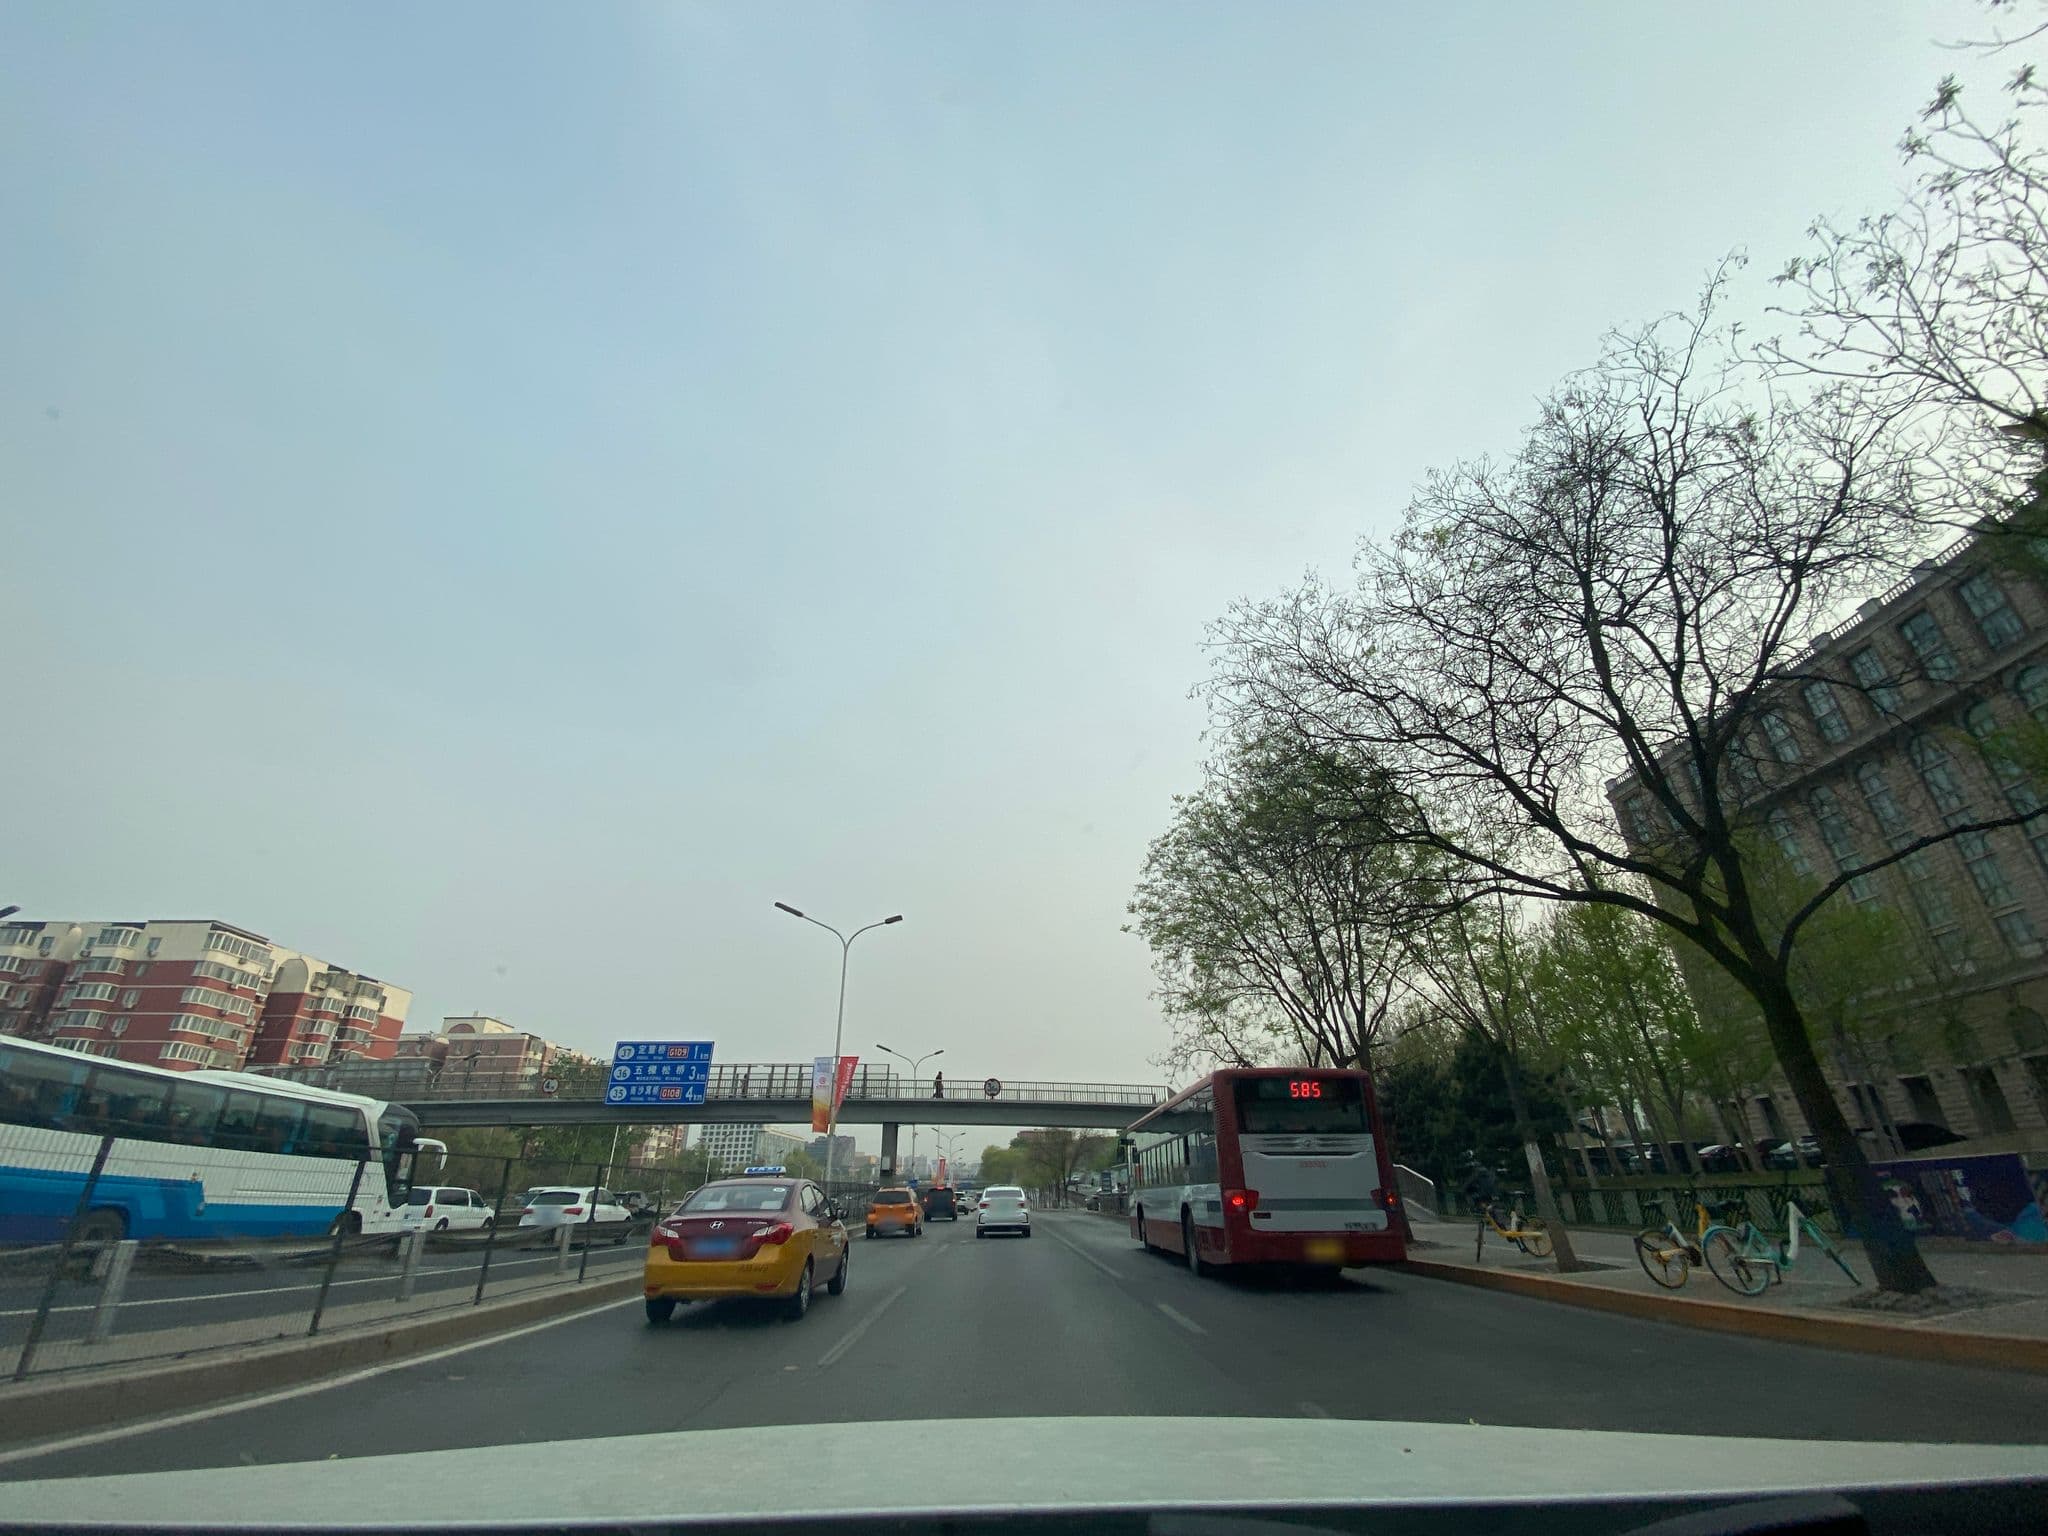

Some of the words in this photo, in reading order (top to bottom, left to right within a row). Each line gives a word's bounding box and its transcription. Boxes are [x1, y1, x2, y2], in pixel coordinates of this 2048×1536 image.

[622, 1048, 631, 1057] 37
[618, 1069, 627, 1077] 36
[688, 1066, 697, 1080] 3
[697, 1073, 706, 1081] km
[614, 1089, 623, 1097] 35
[685, 1086, 693, 1101] 4
[693, 1093, 702, 1101] km
[1289, 1081, 1322, 1098] 585
